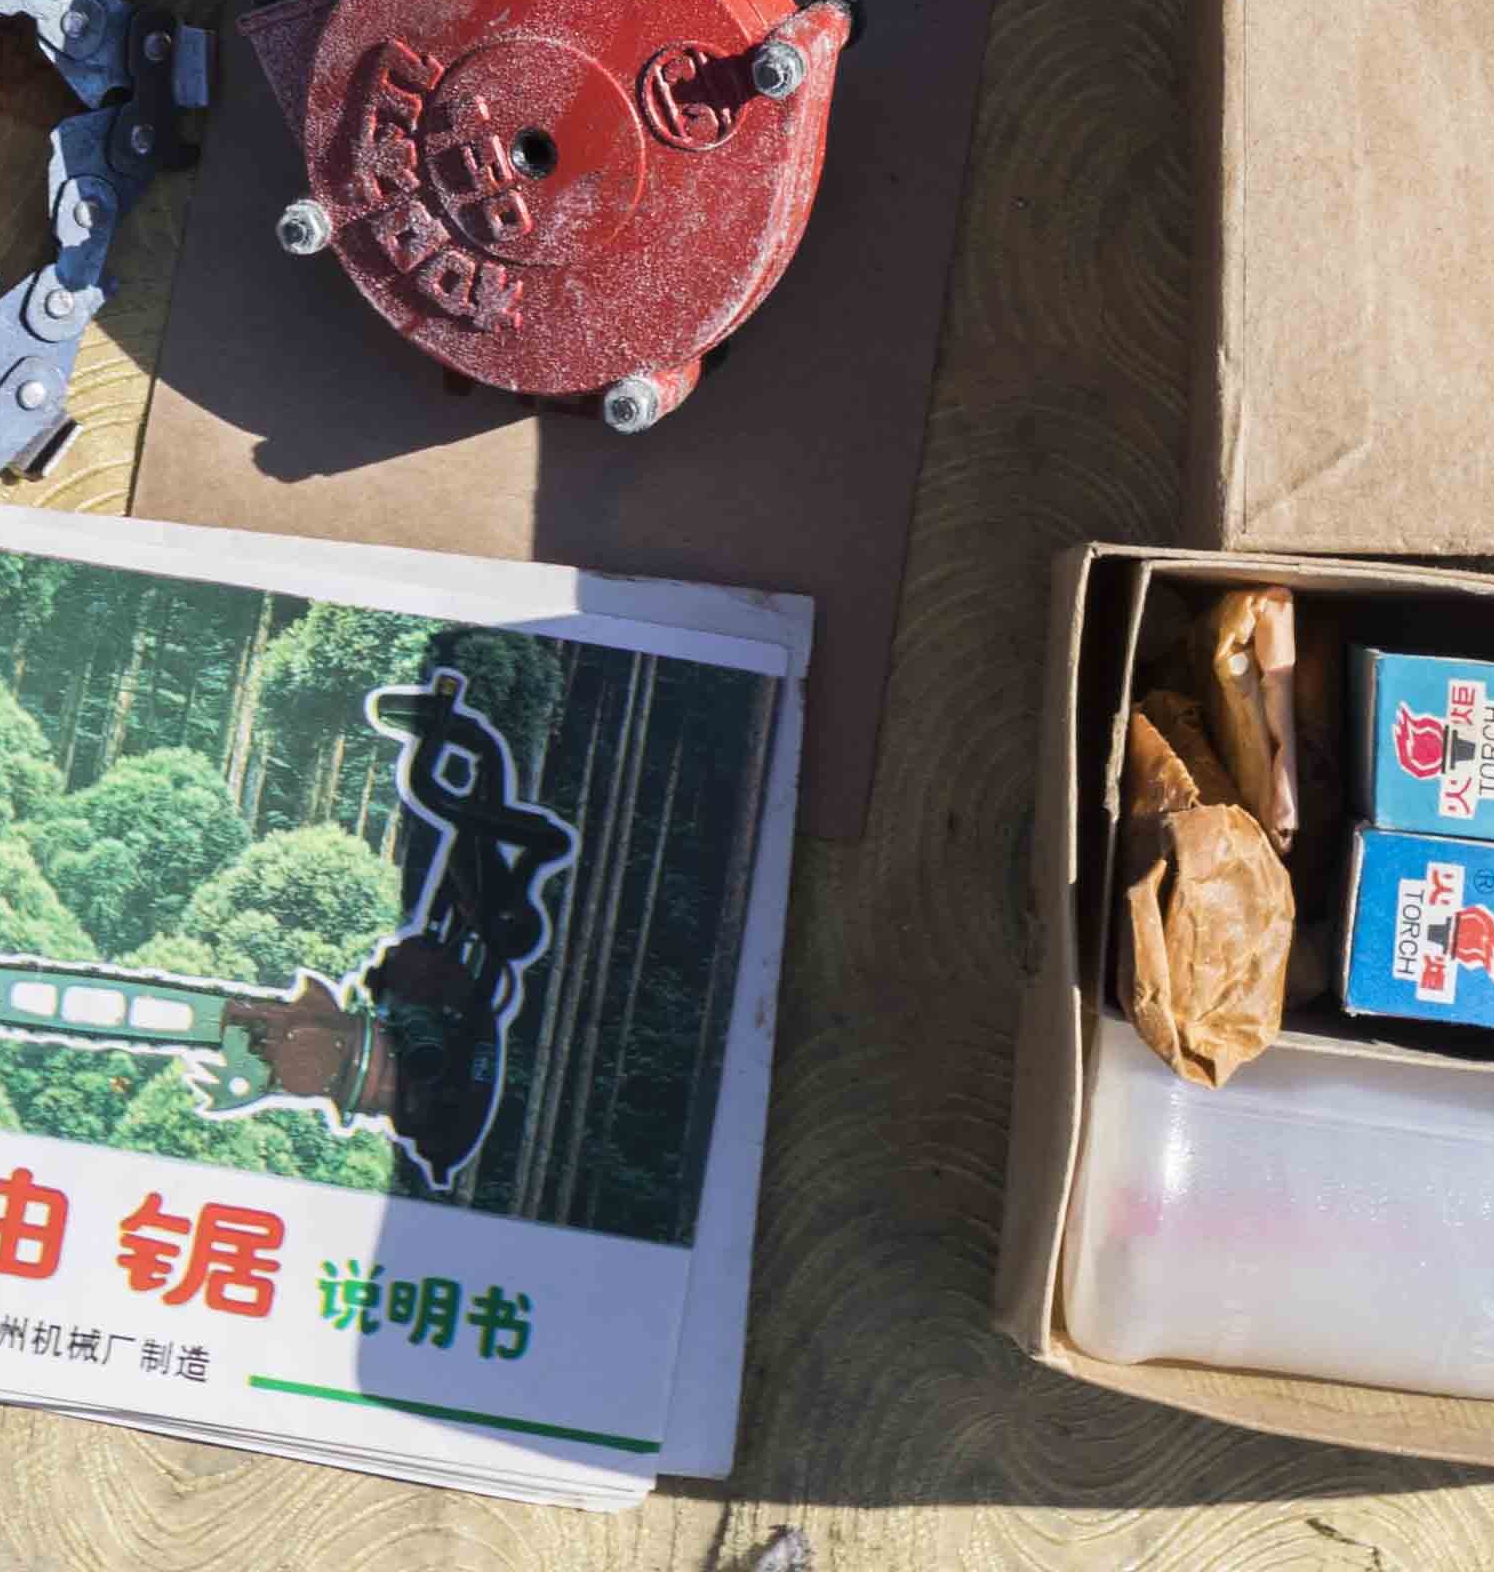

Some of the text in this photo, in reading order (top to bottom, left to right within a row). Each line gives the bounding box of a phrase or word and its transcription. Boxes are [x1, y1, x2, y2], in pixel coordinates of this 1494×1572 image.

[1397, 889, 1426, 976] TORCH
[317, 1258, 538, 1361] 说明书
